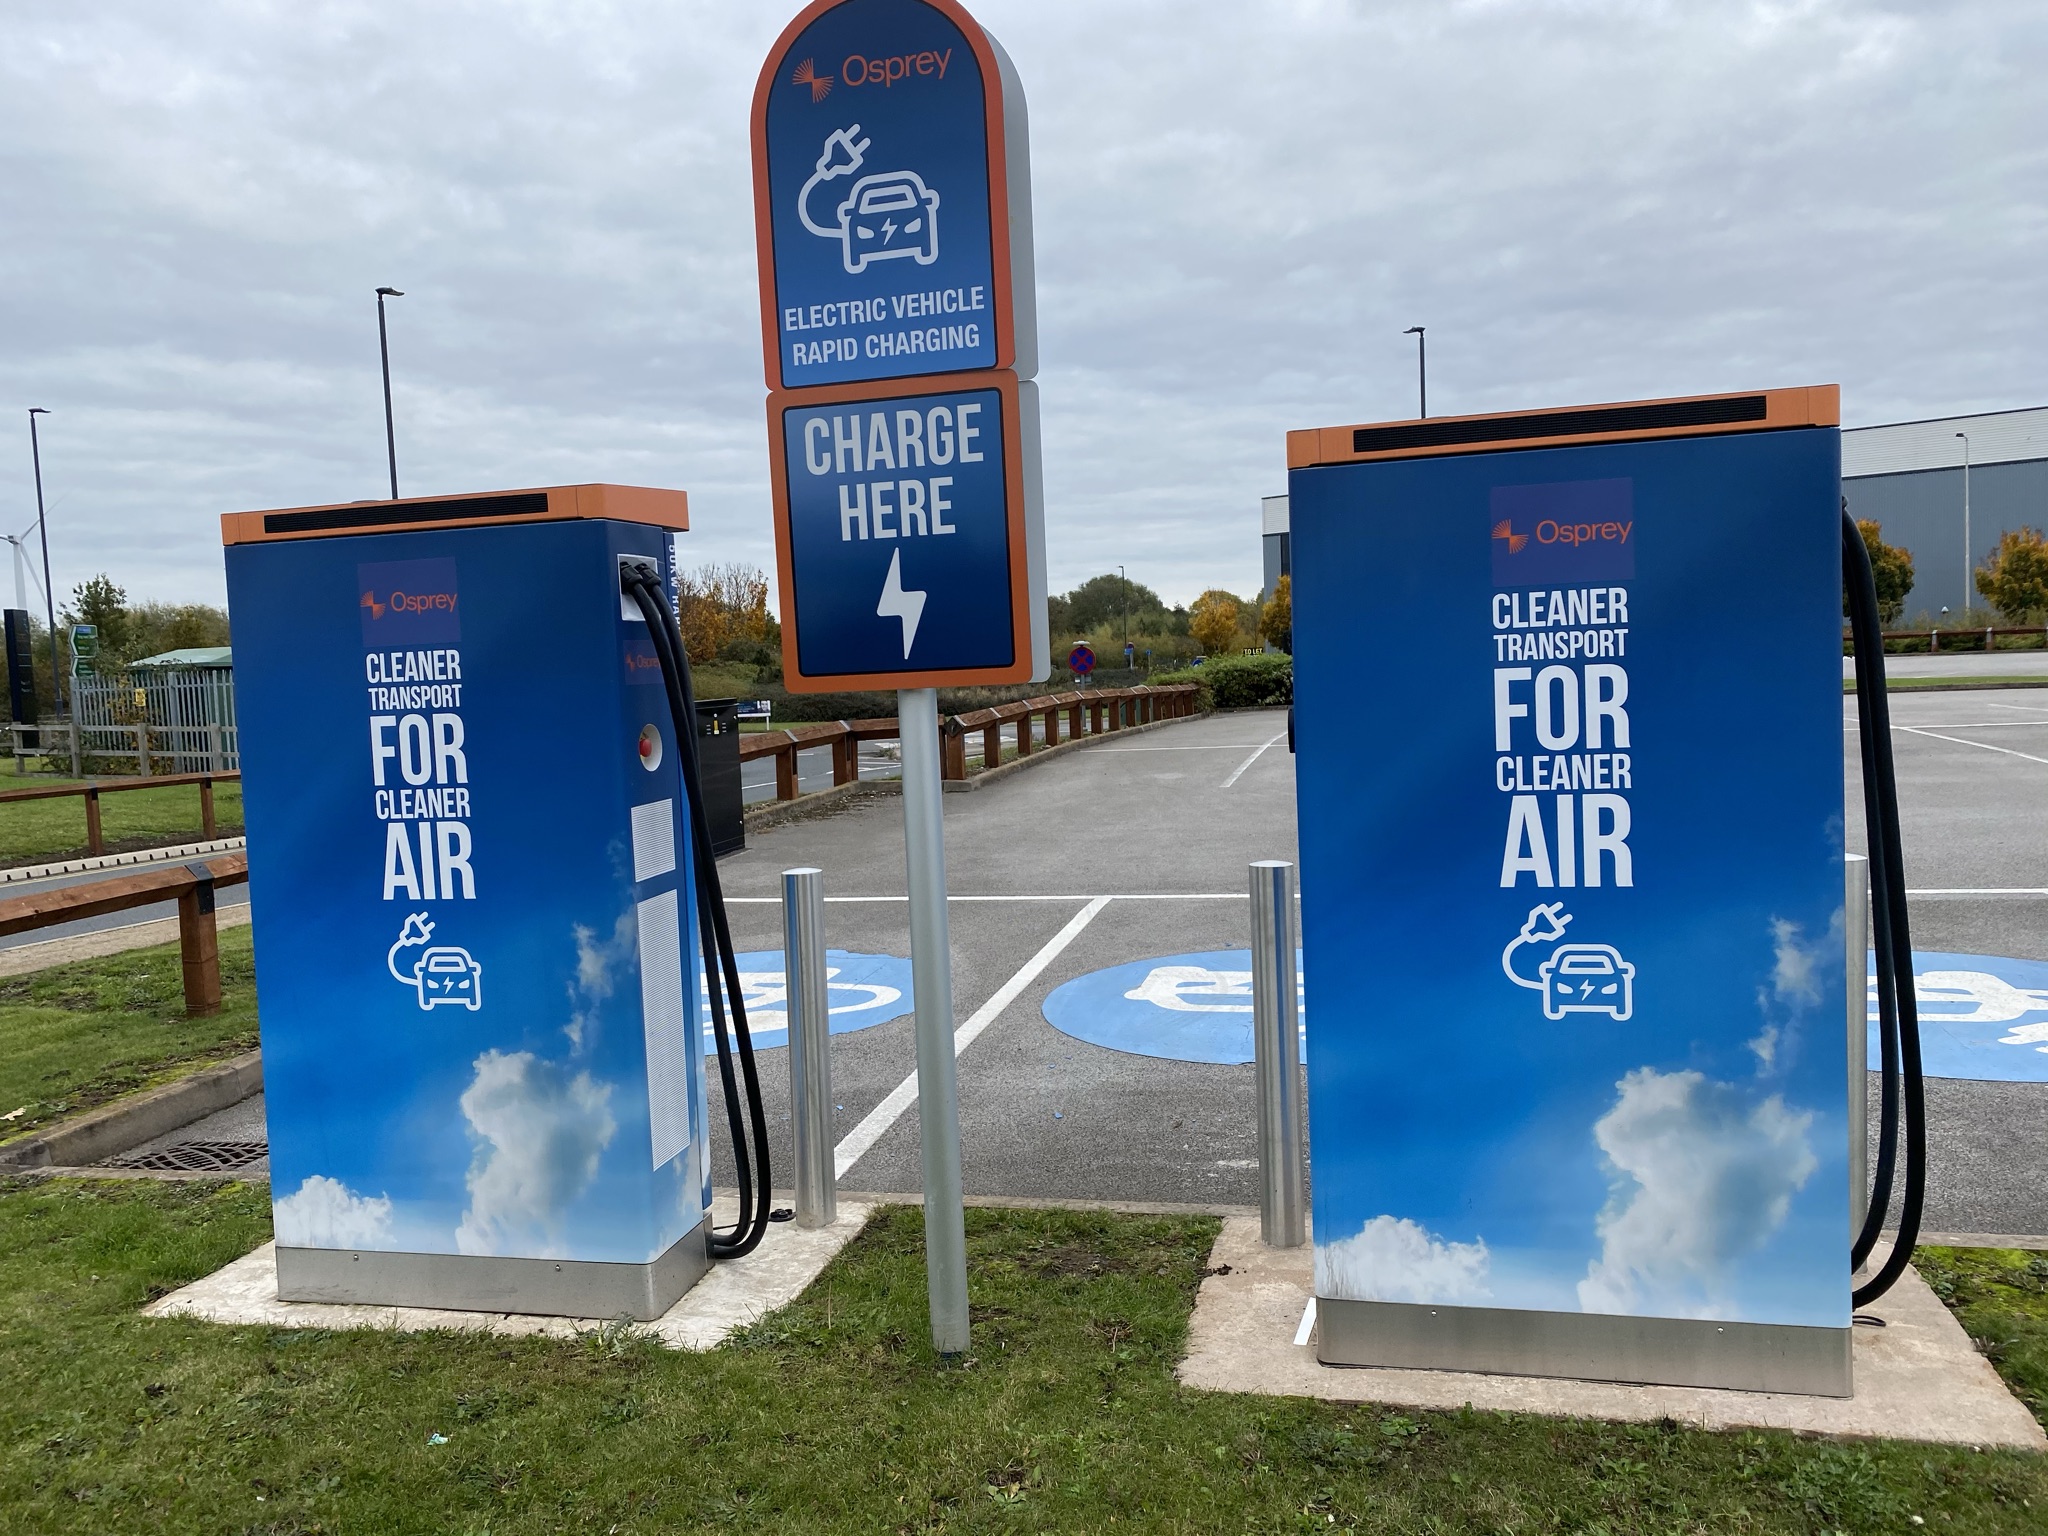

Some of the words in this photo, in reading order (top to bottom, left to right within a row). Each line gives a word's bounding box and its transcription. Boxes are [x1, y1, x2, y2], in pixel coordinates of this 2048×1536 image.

[843, 48, 951, 88] Osprey
[785, 297, 887, 331] ELECTRIC
[891, 287, 985, 319] VEHICLE
[792, 338, 858, 366] RAPID
[863, 324, 980, 358] CHARGING
[804, 403, 984, 476] CHARGE
[838, 476, 956, 541] HERE
[1536, 519, 1633, 547] Osprey
[391, 591, 457, 615] Osprey
[1492, 587, 1629, 629] CLEANER
[366, 649, 462, 684] CLEANER
[1493, 629, 1629, 662] TRANSPORT
[368, 684, 462, 711] TRANSPORT
[1494, 664, 1631, 752] FOR
[370, 713, 469, 786] FOR
[1496, 753, 1632, 792] CLEANER
[375, 787, 470, 819] CLEANER
[383, 821, 477, 901] AIR
[1499, 794, 1634, 888] AIR
